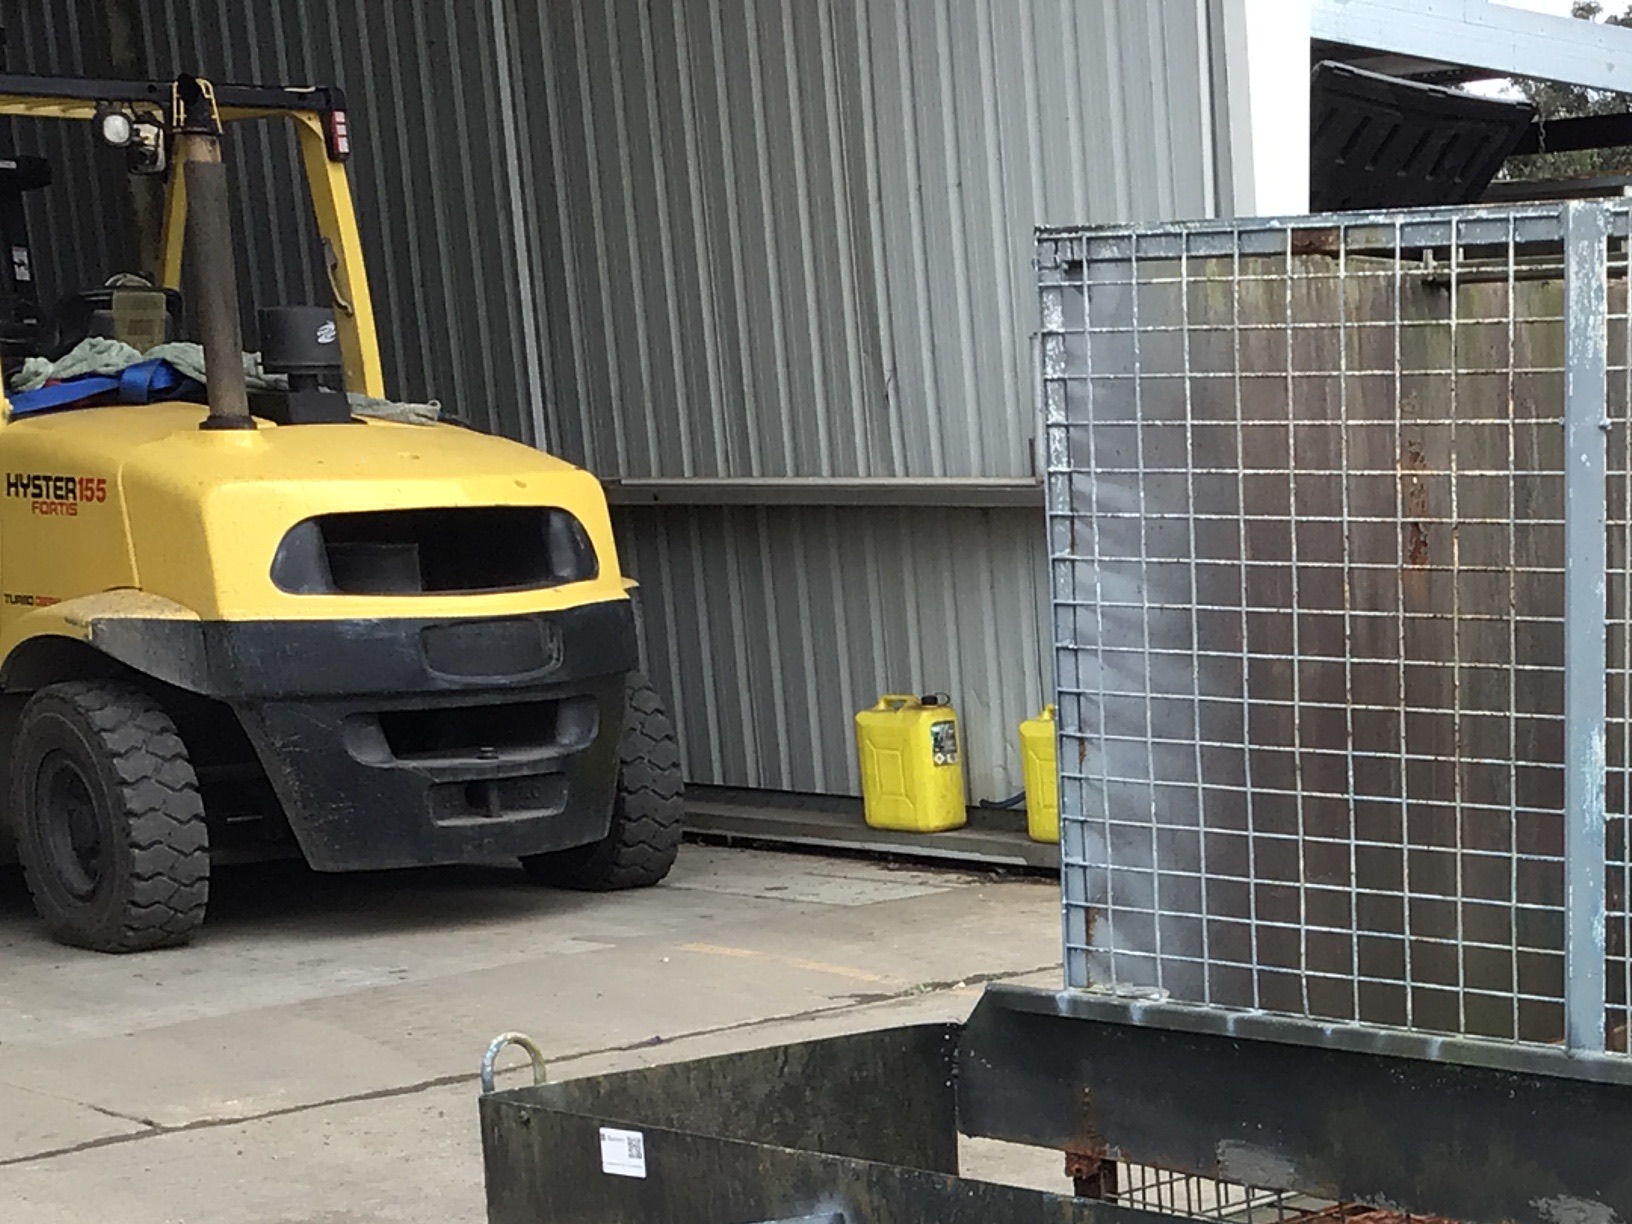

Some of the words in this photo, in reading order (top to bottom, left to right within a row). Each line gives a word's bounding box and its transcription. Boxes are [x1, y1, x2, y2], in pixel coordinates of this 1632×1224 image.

[6, 473, 77, 500] HYSTER
[78, 477, 107, 503] 155
[32, 501, 78, 516] FORTIS
